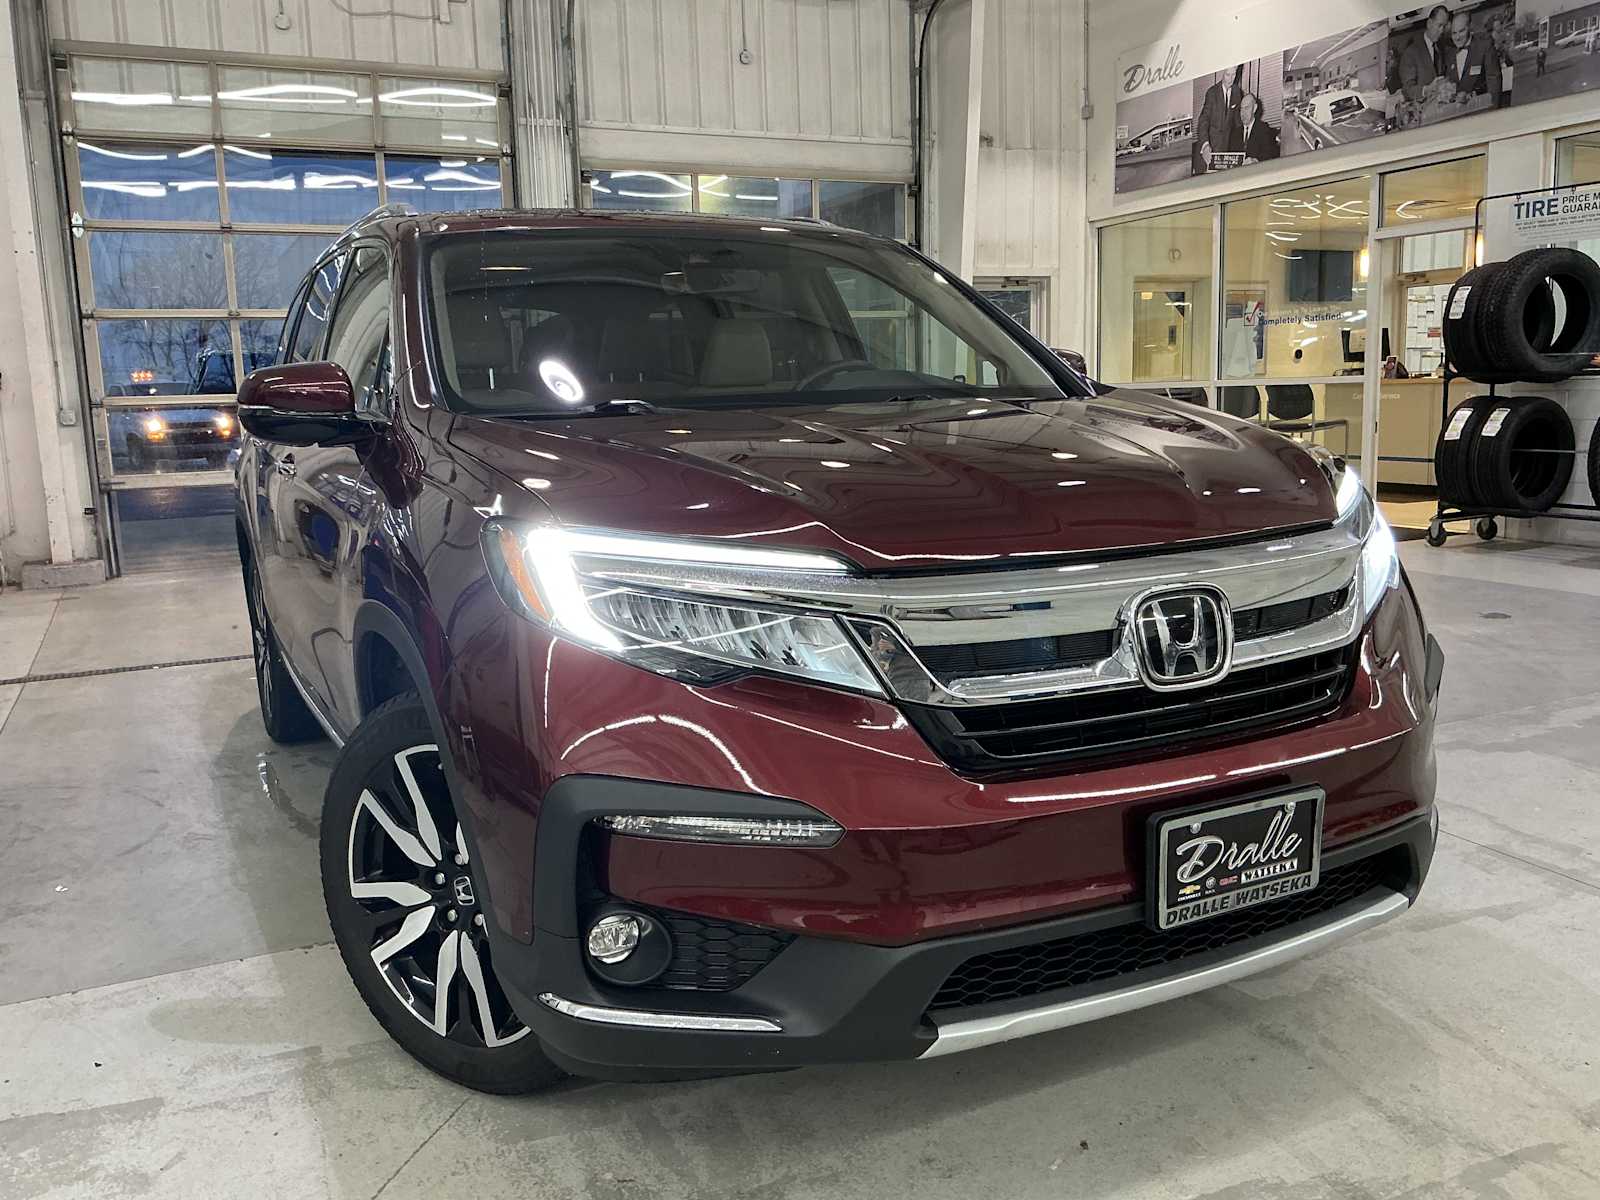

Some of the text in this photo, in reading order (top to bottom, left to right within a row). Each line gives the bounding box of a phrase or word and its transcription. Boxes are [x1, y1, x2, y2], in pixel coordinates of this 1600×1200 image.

[1124, 44, 1184, 93] Dralle
[1513, 198, 1559, 219] TIRE
[1562, 193, 1590, 204] PRICE
[1562, 201, 1600, 214] GUARA
[1176, 810, 1302, 883] Dralle
[1243, 860, 1296, 881] WATSEKA
[1165, 874, 1312, 926] DRALLE WATSEKA
